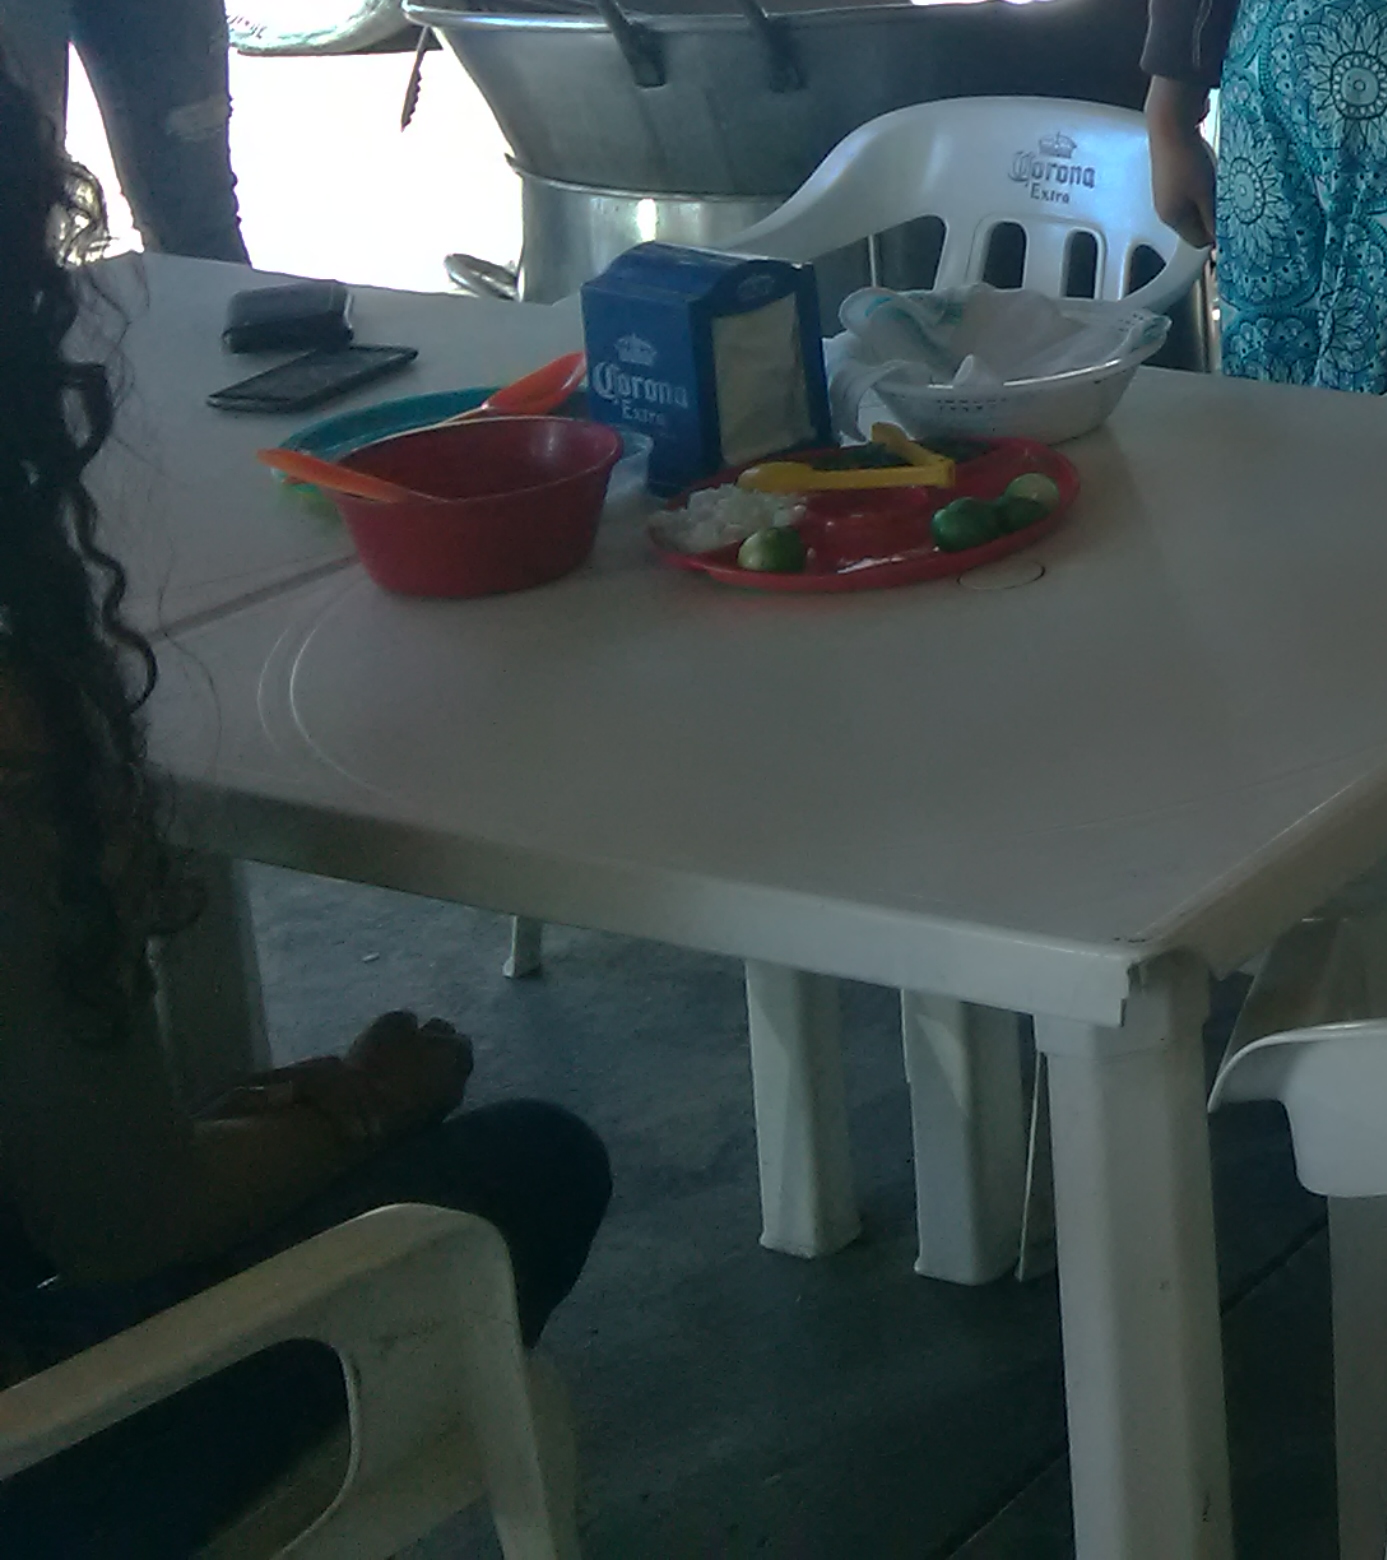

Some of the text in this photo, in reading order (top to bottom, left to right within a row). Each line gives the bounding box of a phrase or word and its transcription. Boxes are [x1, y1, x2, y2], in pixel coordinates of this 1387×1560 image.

[1008, 150, 1095, 189] Corona
[1030, 182, 1070, 204] Extra
[592, 361, 689, 409] Corona
[621, 399, 666, 425] Extra
